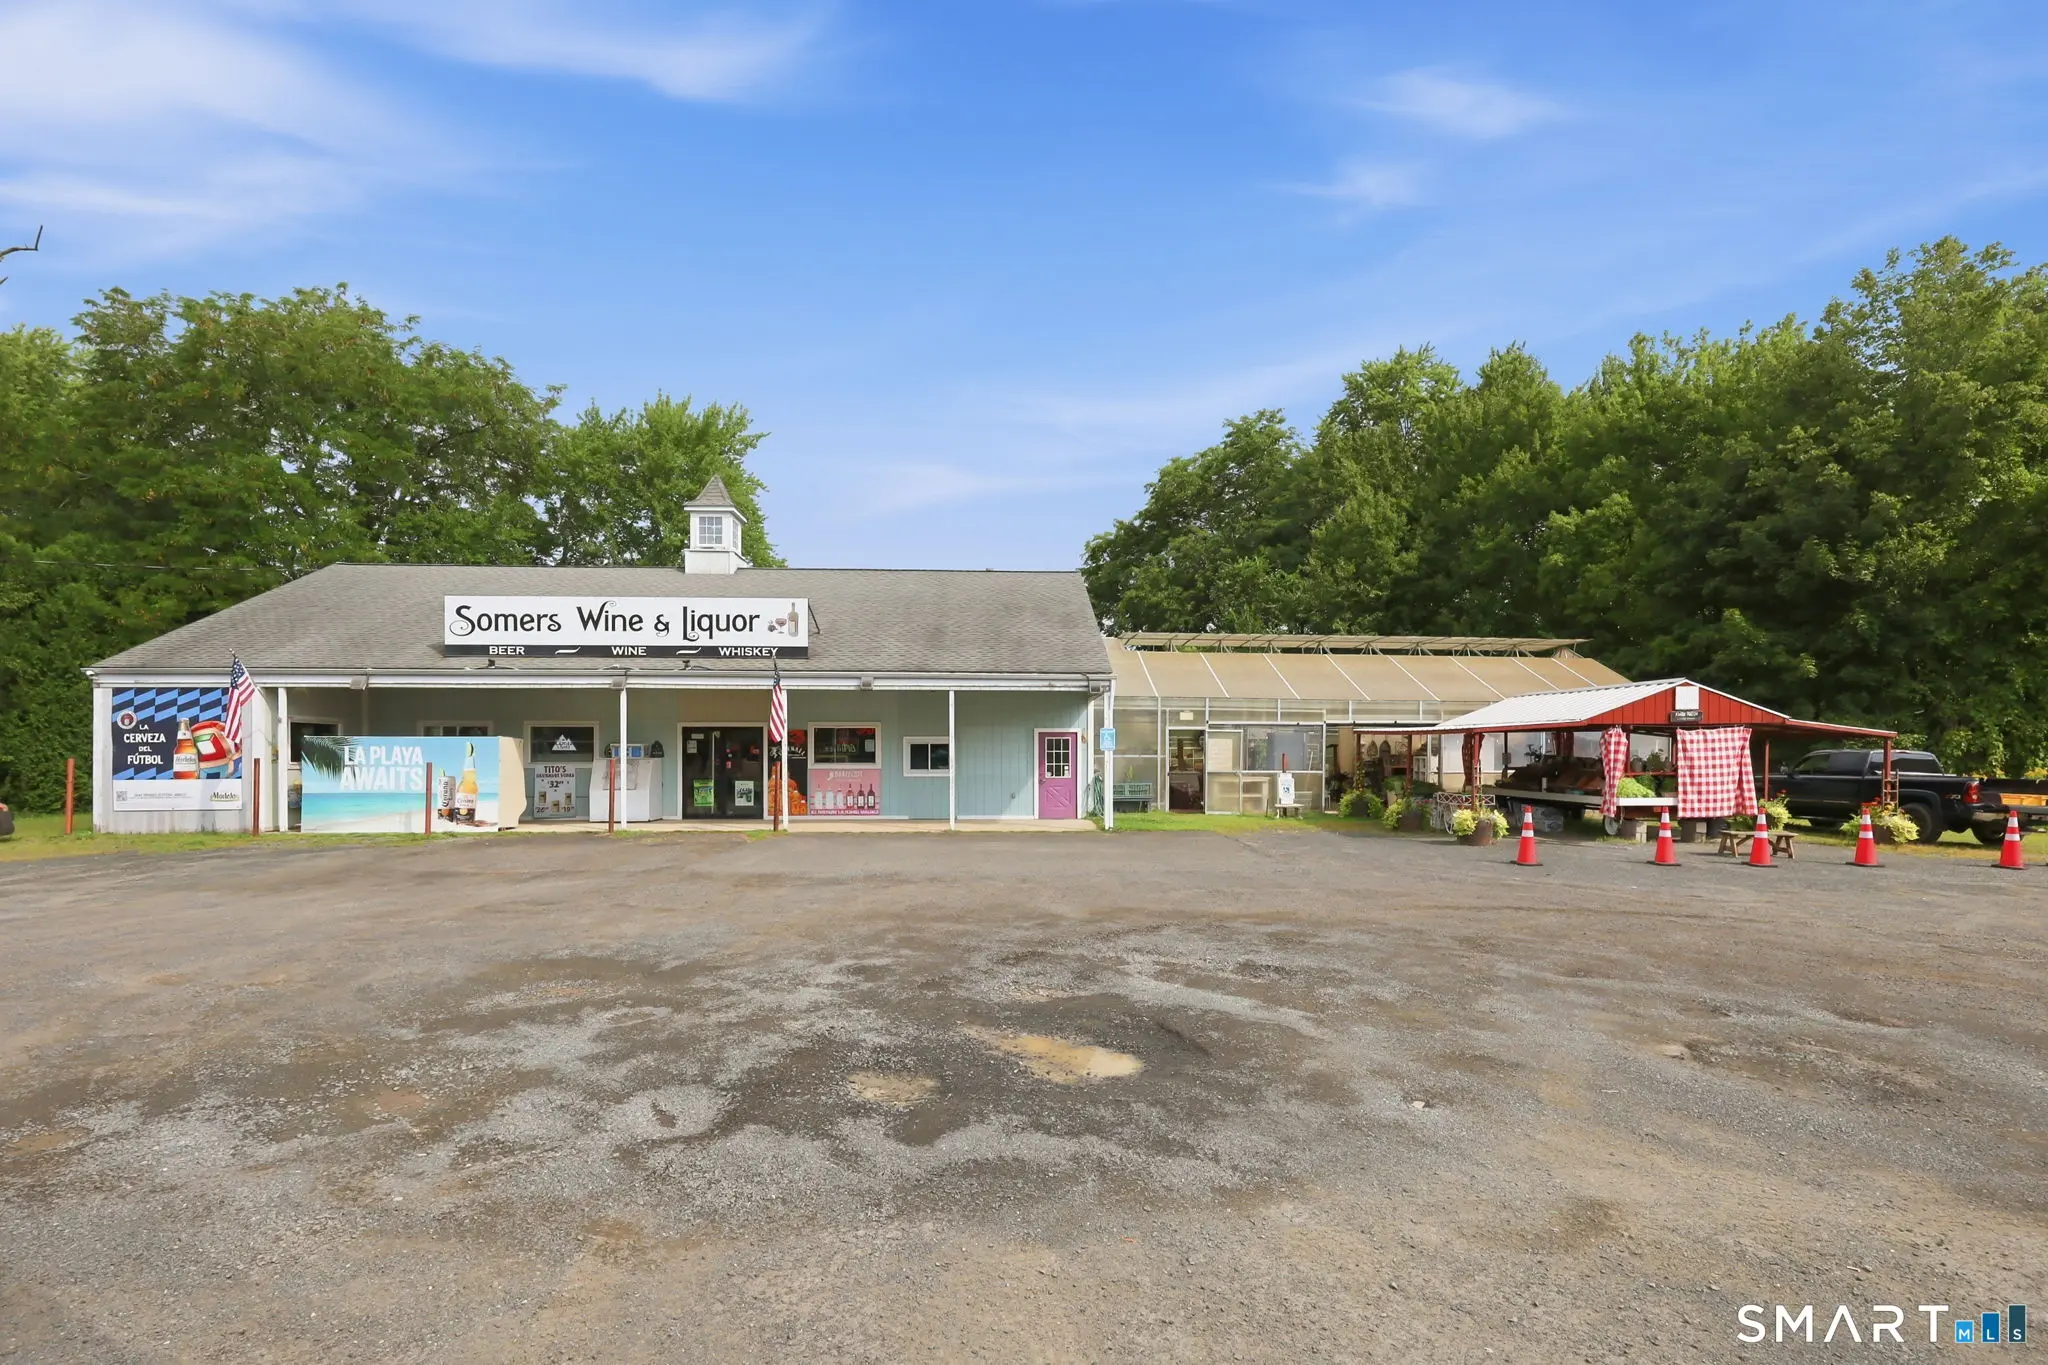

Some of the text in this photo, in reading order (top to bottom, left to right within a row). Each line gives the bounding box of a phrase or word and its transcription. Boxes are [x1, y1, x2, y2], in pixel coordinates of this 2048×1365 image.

[449, 600, 760, 642] Somers Wine & Liquor
[488, 645, 779, 657] BEER WINE WHISKEY
[123, 733, 167, 743] CERVEZA
[127, 753, 164, 765] FÚTBOL
[344, 745, 424, 765] LA PLAYA
[544, 765, 567, 773] TITO'S
[340, 766, 425, 791] AWAITS
[211, 791, 238, 800] Modelo
